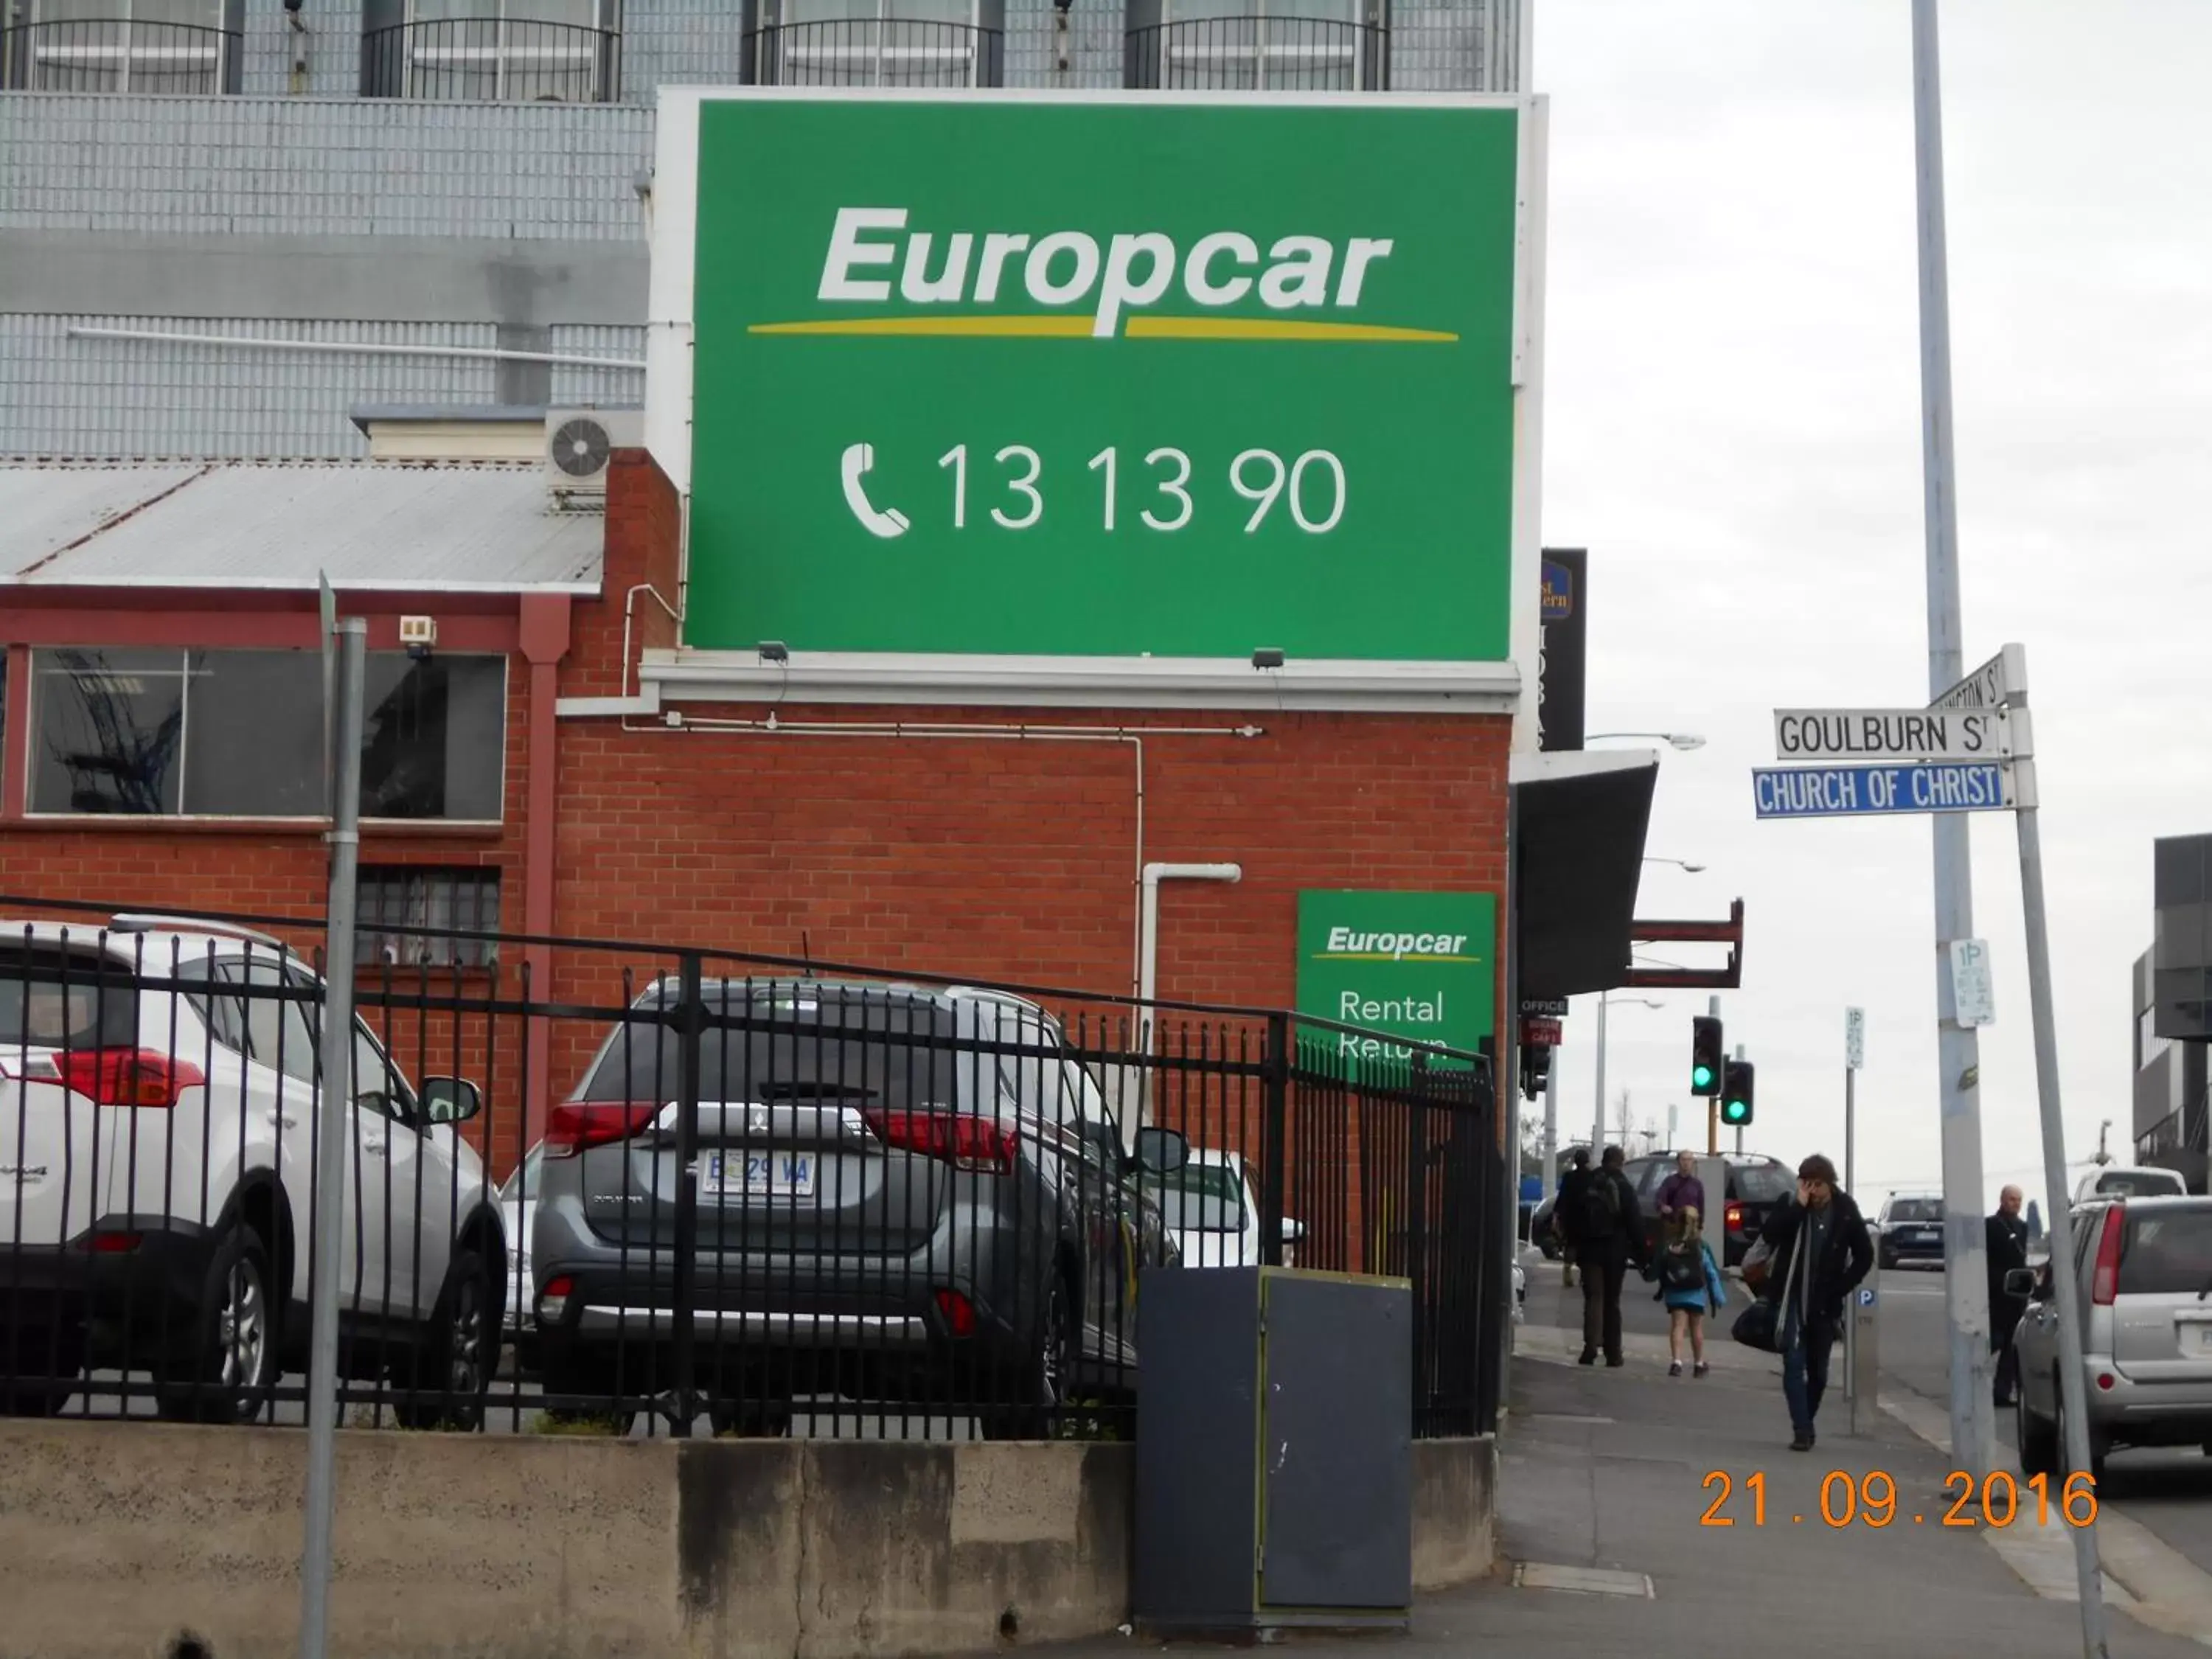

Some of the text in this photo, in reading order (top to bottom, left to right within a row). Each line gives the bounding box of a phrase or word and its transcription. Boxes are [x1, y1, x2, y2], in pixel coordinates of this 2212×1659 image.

[817, 206, 1394, 338] Europcar
[938, 444, 1346, 533] 13 13 90
[1987, 664, 1999, 703] ST
[1780, 715, 1989, 754] GOULBURN ST
[1756, 765, 1997, 811] CHURCH OF CHRIST
[1327, 927, 1467, 961] Europcar
[1340, 990, 1443, 1022] Rental
